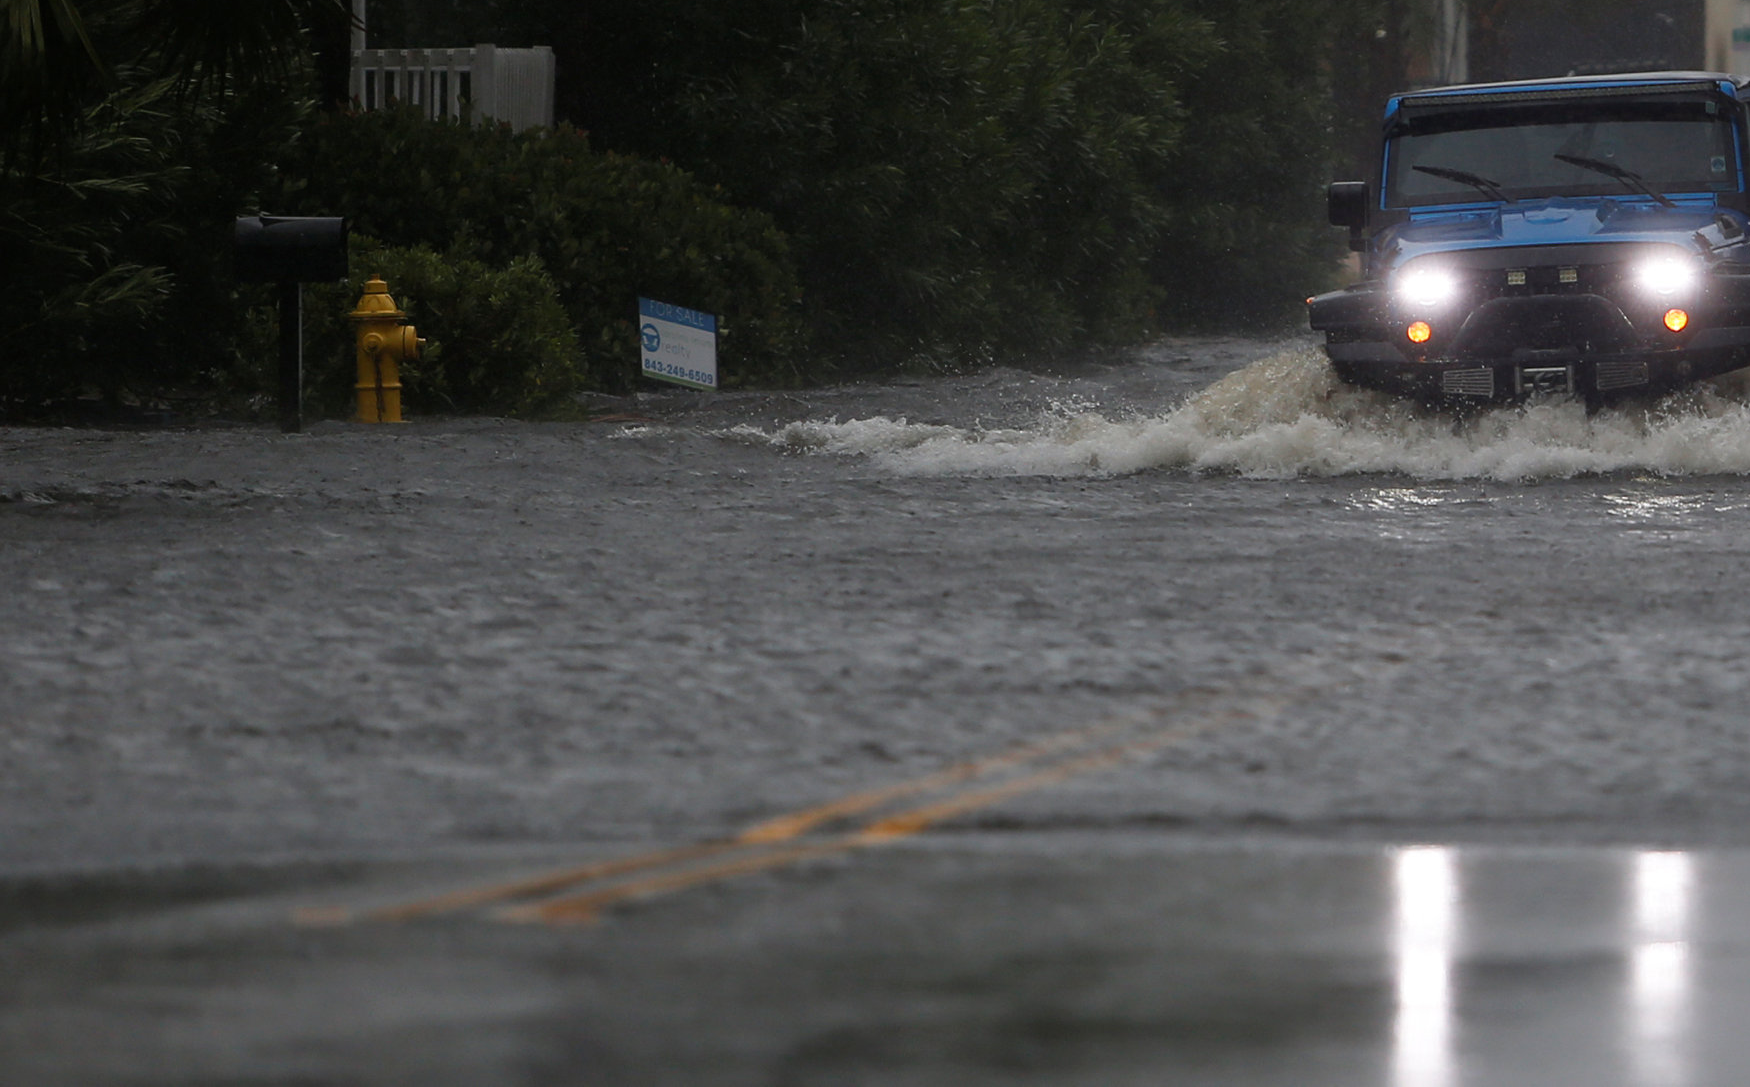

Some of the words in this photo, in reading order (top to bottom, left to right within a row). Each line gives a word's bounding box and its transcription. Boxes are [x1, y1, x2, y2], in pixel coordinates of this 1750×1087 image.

[650, 300, 672, 318] FOR
[676, 307, 705, 326] SALE
[644, 358, 713, 384] 843-249-6509
